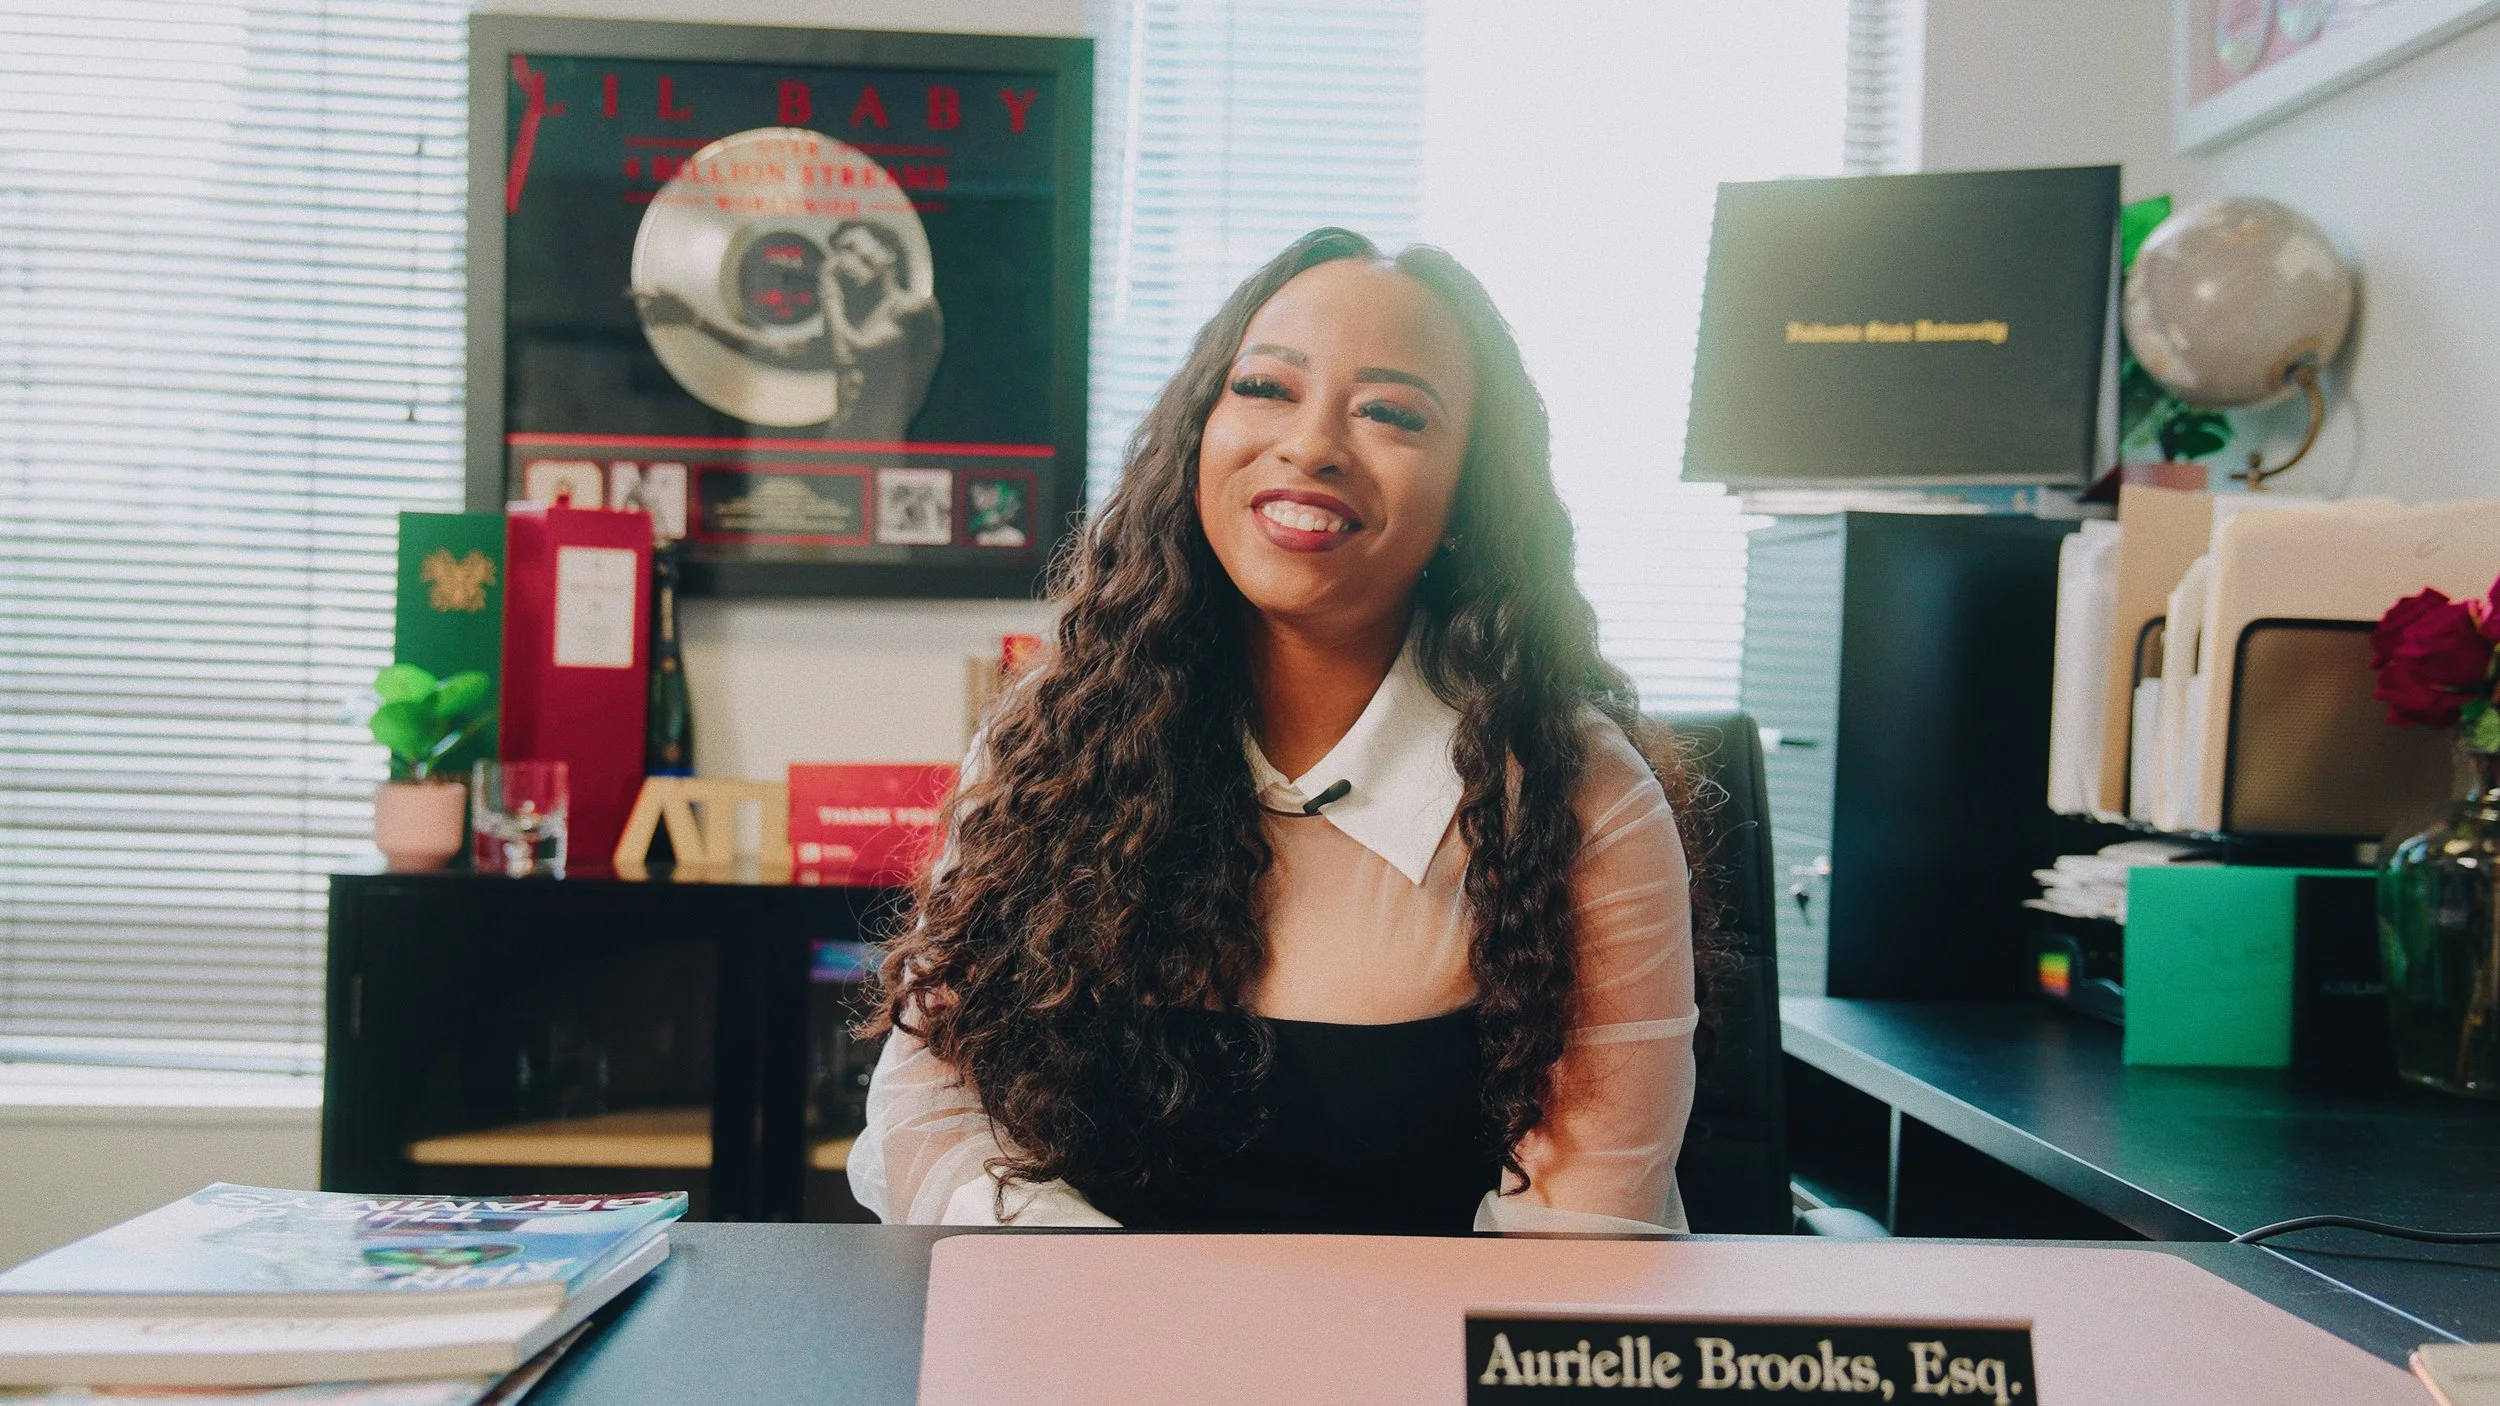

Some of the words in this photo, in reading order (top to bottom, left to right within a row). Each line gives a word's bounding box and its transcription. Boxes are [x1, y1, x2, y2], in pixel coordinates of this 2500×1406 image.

[530, 71, 693, 121] LIL
[777, 79, 1037, 133] BABY
[653, 156, 786, 185] BILLION
[803, 162, 948, 190] STREAMS
[1914, 318, 2008, 345] University
[818, 806, 891, 826] THANK
[1479, 1332, 1683, 1389] Aurielle
[1695, 1336, 1895, 1401] Brooks,
[1907, 1340, 2022, 1406] Esq.
